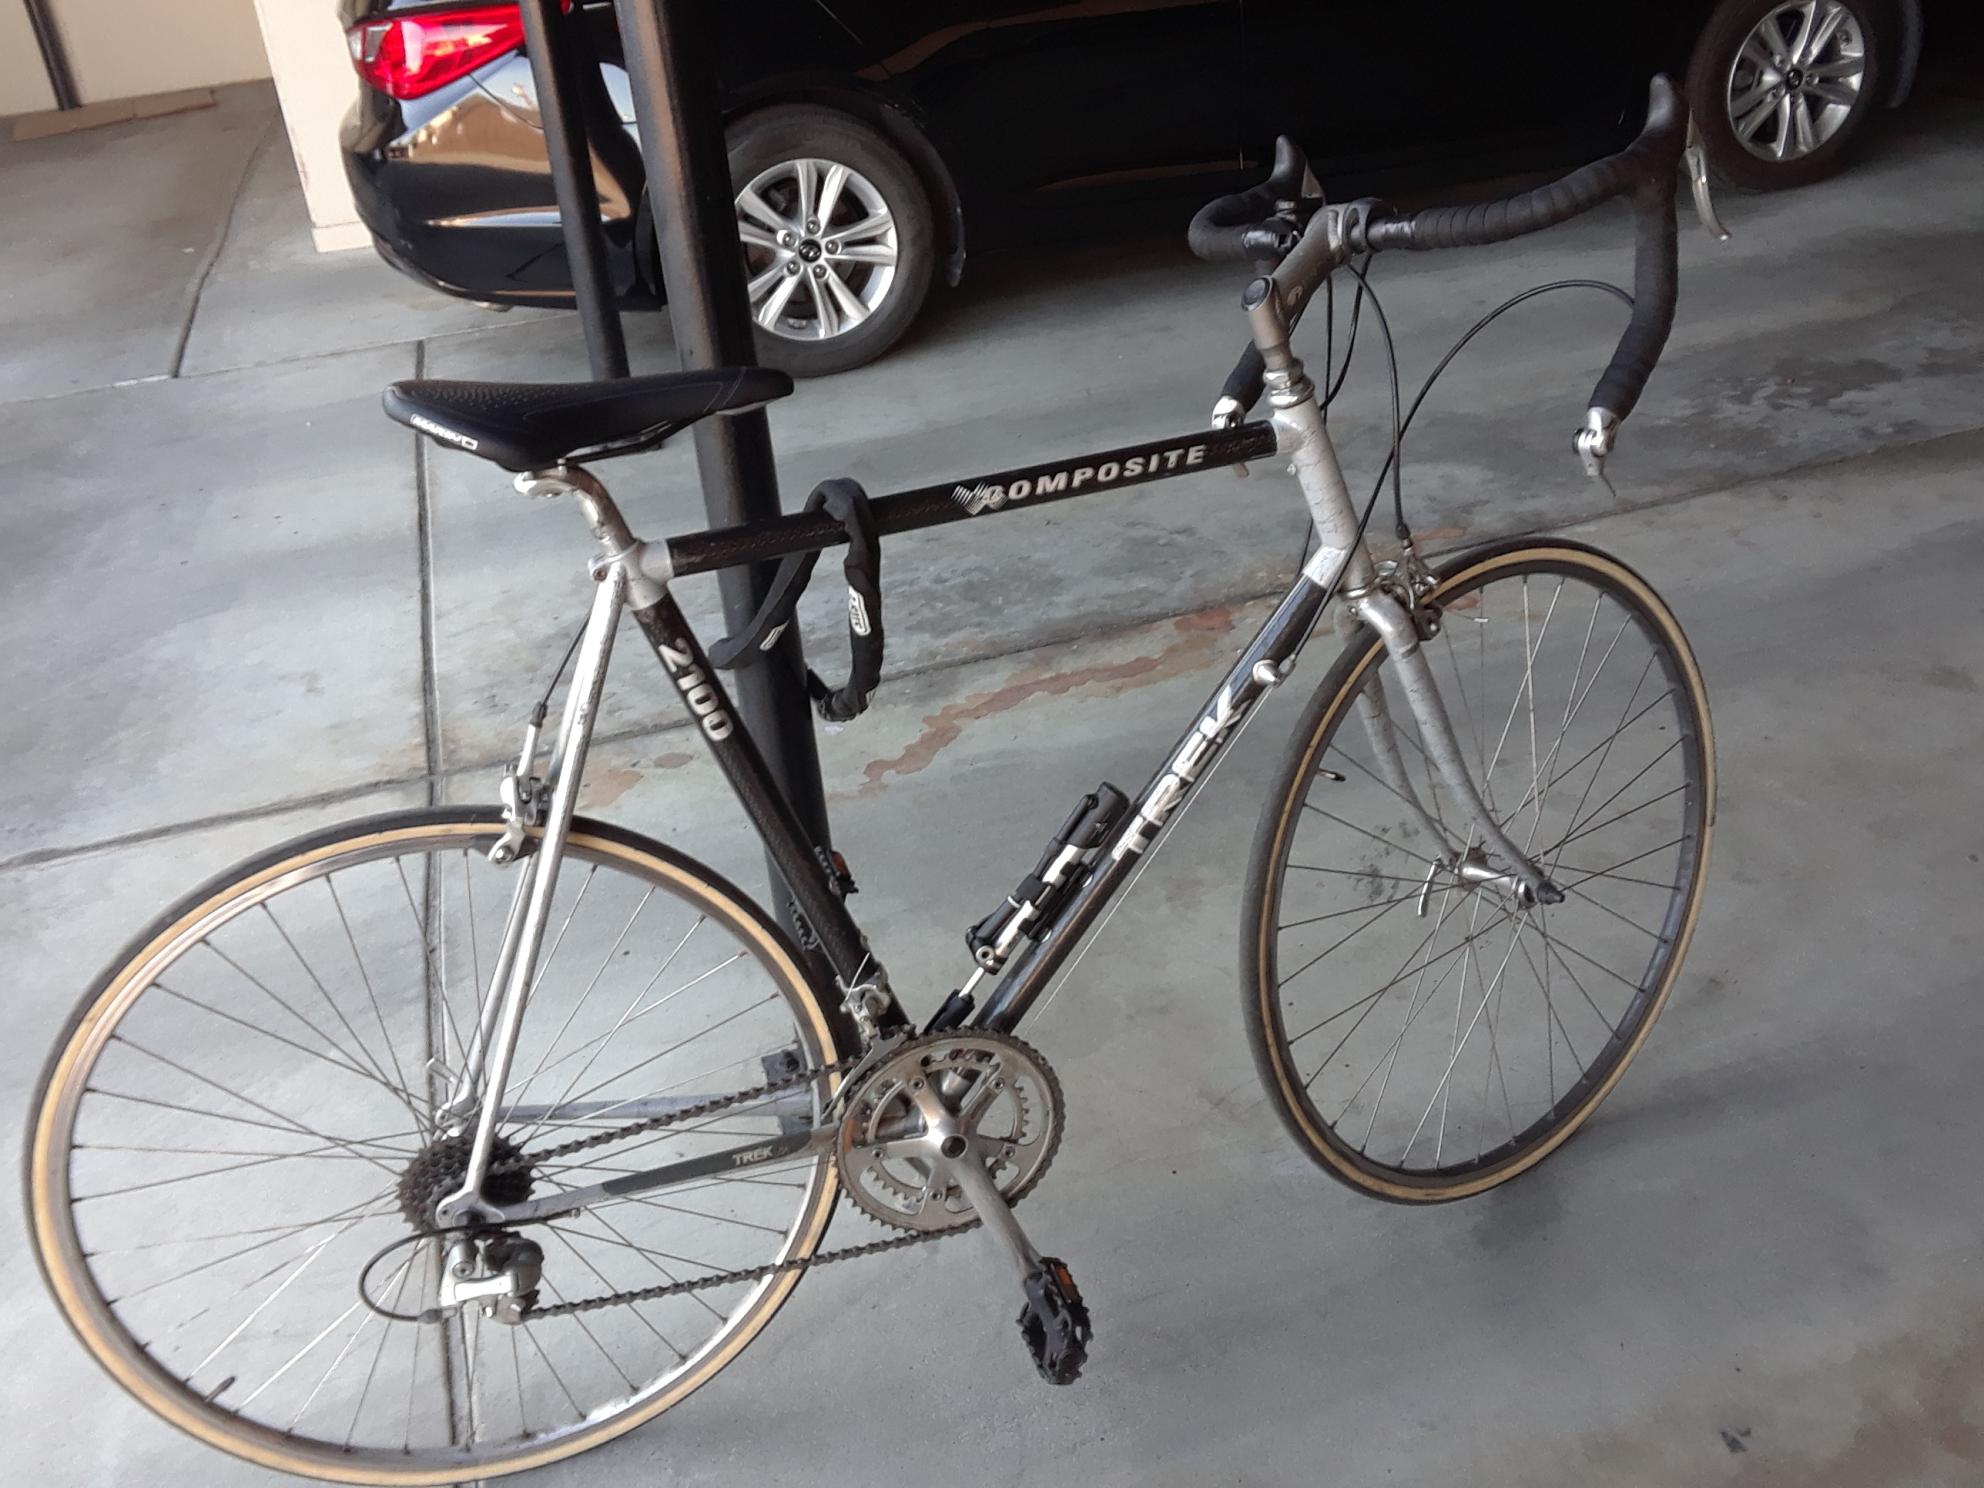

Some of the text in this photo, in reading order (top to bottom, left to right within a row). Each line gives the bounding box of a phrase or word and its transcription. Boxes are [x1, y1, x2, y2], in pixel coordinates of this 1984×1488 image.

[659, 638, 733, 740] 2100
[1112, 686, 1250, 861] TREK
[733, 1146, 773, 1165] TREK
